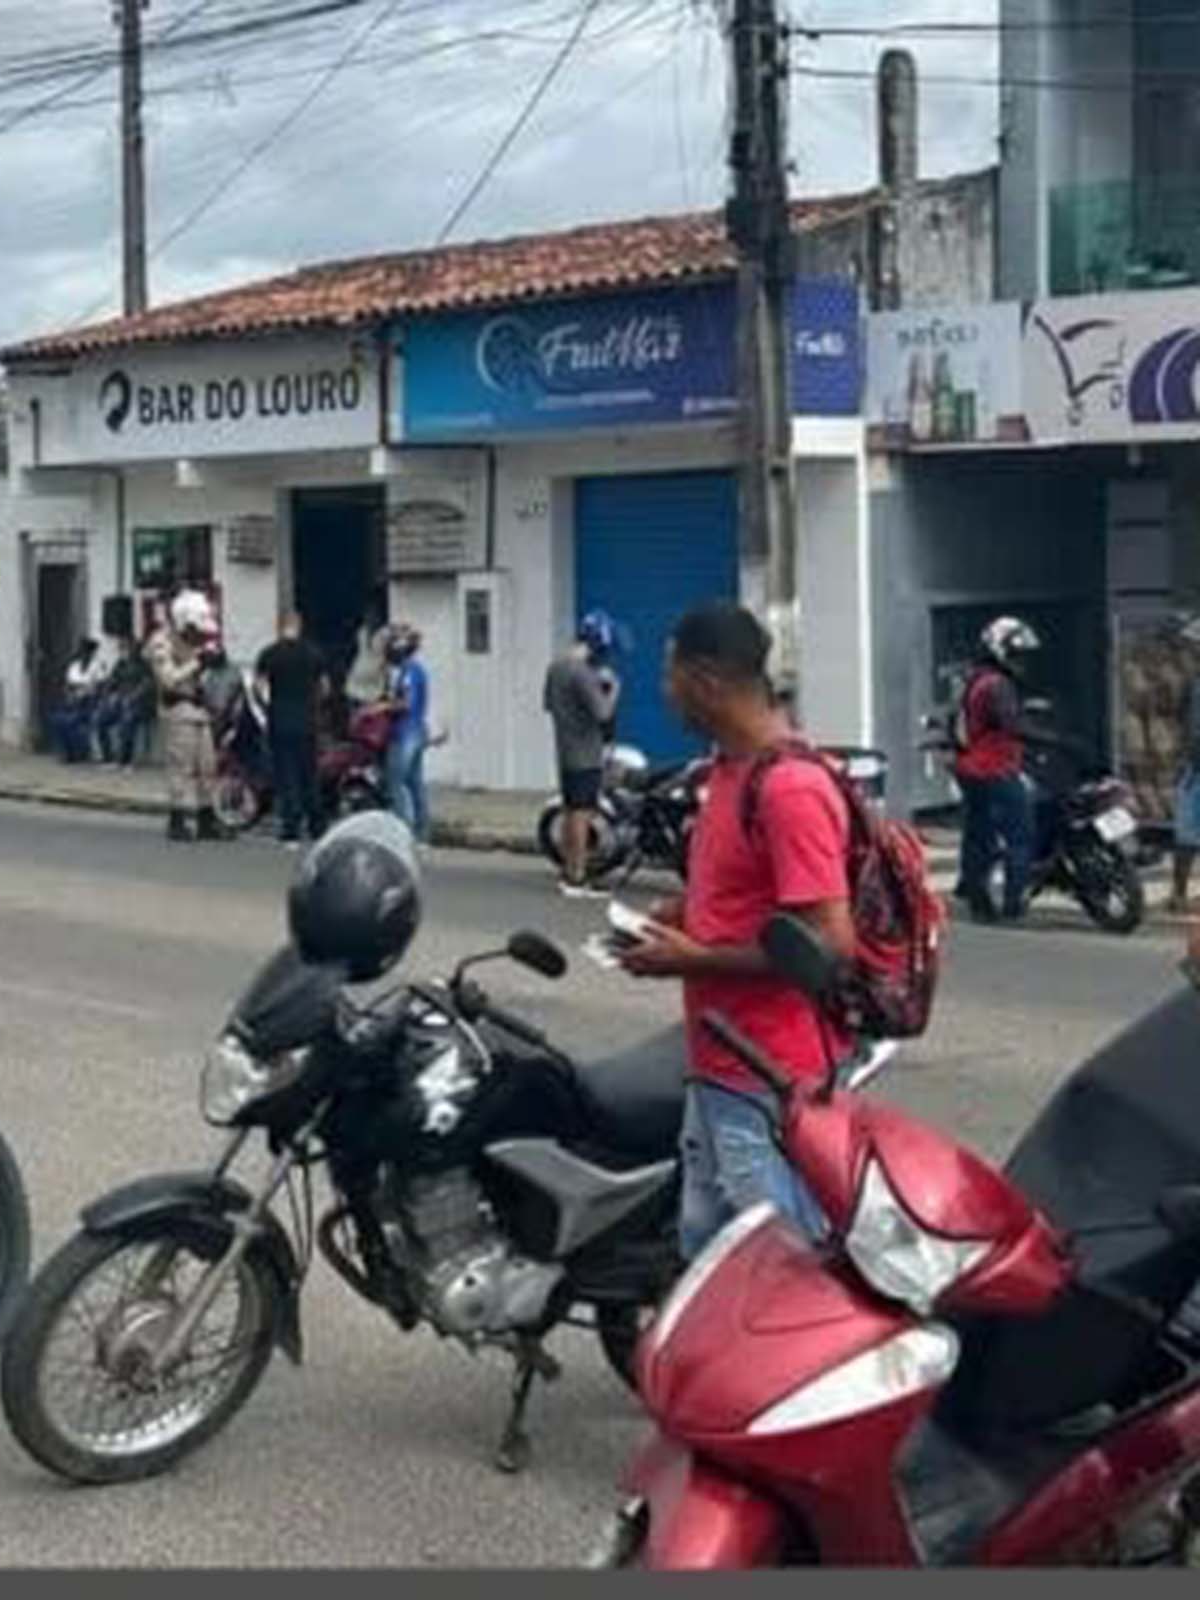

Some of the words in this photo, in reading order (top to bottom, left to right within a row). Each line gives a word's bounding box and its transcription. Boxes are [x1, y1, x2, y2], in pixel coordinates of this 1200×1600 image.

[138, 383, 195, 426] BAR
[205, 378, 246, 420] DO
[256, 367, 361, 417] LOURO
